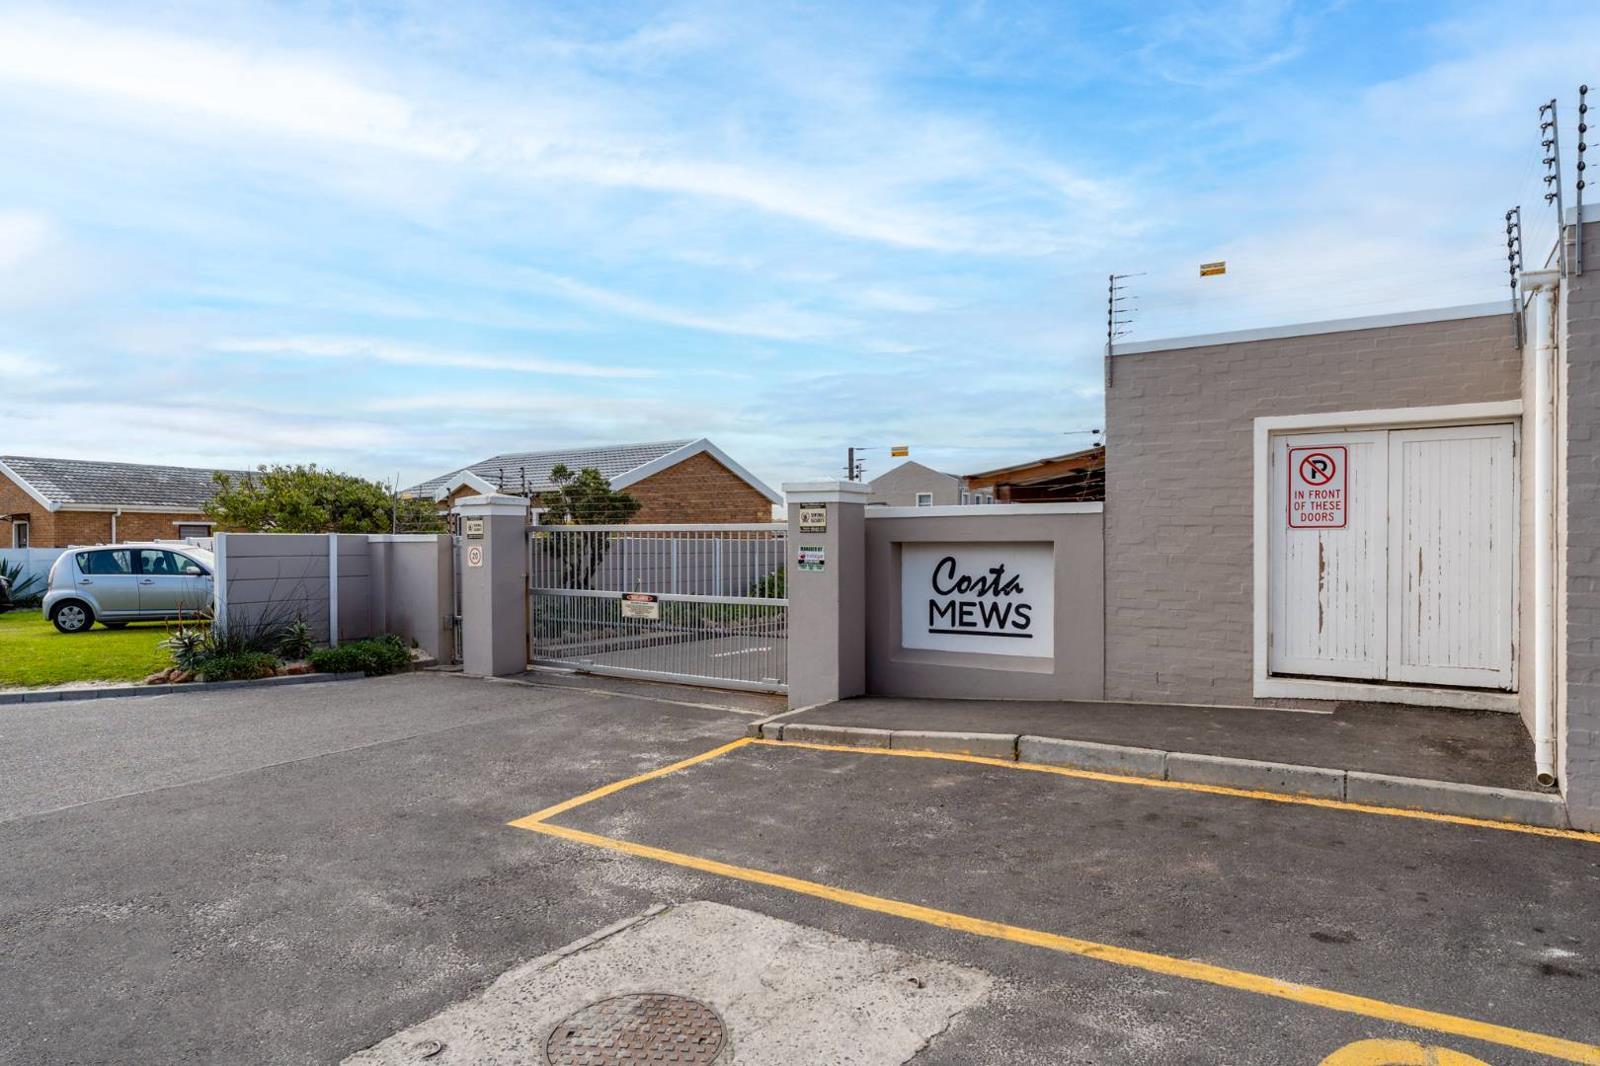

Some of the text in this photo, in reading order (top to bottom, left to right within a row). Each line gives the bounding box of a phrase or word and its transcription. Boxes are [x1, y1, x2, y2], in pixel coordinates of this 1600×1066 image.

[1294, 489, 1341, 500] IN FRONT
[1294, 501, 1342, 511] OF THESE
[1300, 512, 1335, 522] DOORS
[932, 556, 1024, 597] Costa
[929, 599, 1032, 630] MEWS
